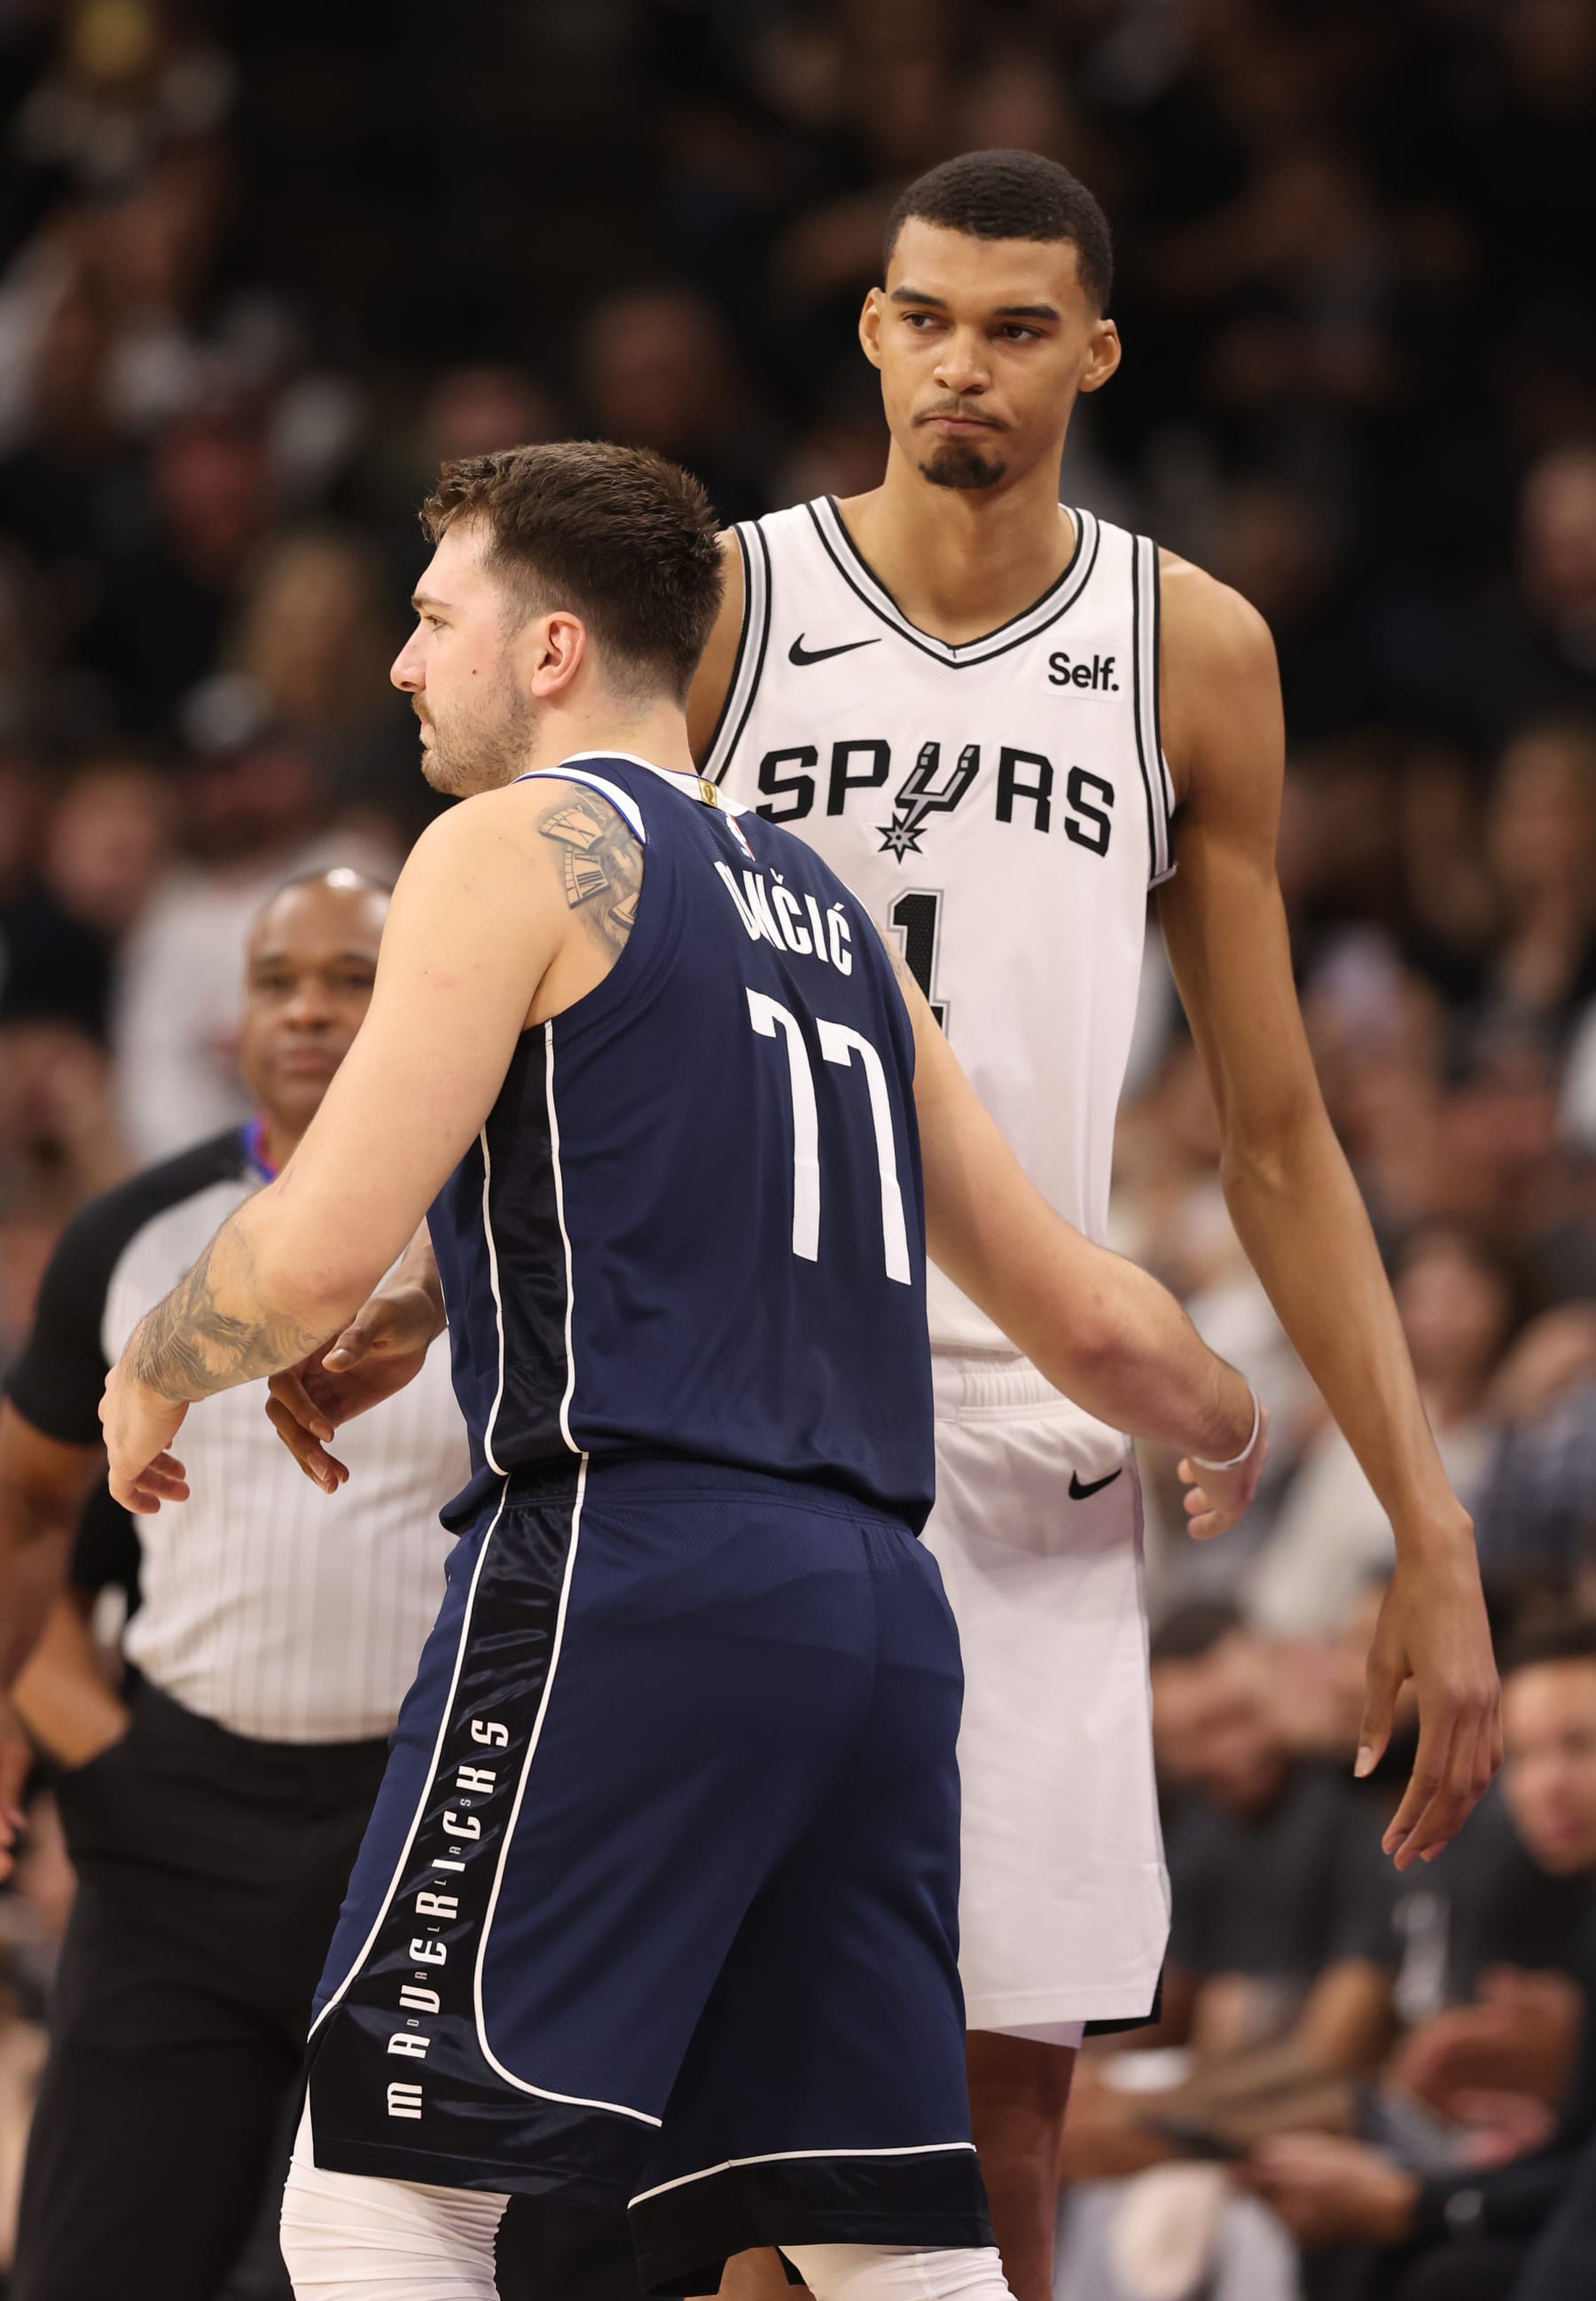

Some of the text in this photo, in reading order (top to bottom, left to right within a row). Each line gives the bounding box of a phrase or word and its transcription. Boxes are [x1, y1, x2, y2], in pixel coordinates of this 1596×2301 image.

[1047, 652, 1120, 693] Self.
[755, 740, 1115, 864] SPURS
[888, 887, 951, 1039] 1
[746, 986, 912, 1286] 77
[387, 1718, 511, 2120] MAVERICKS
